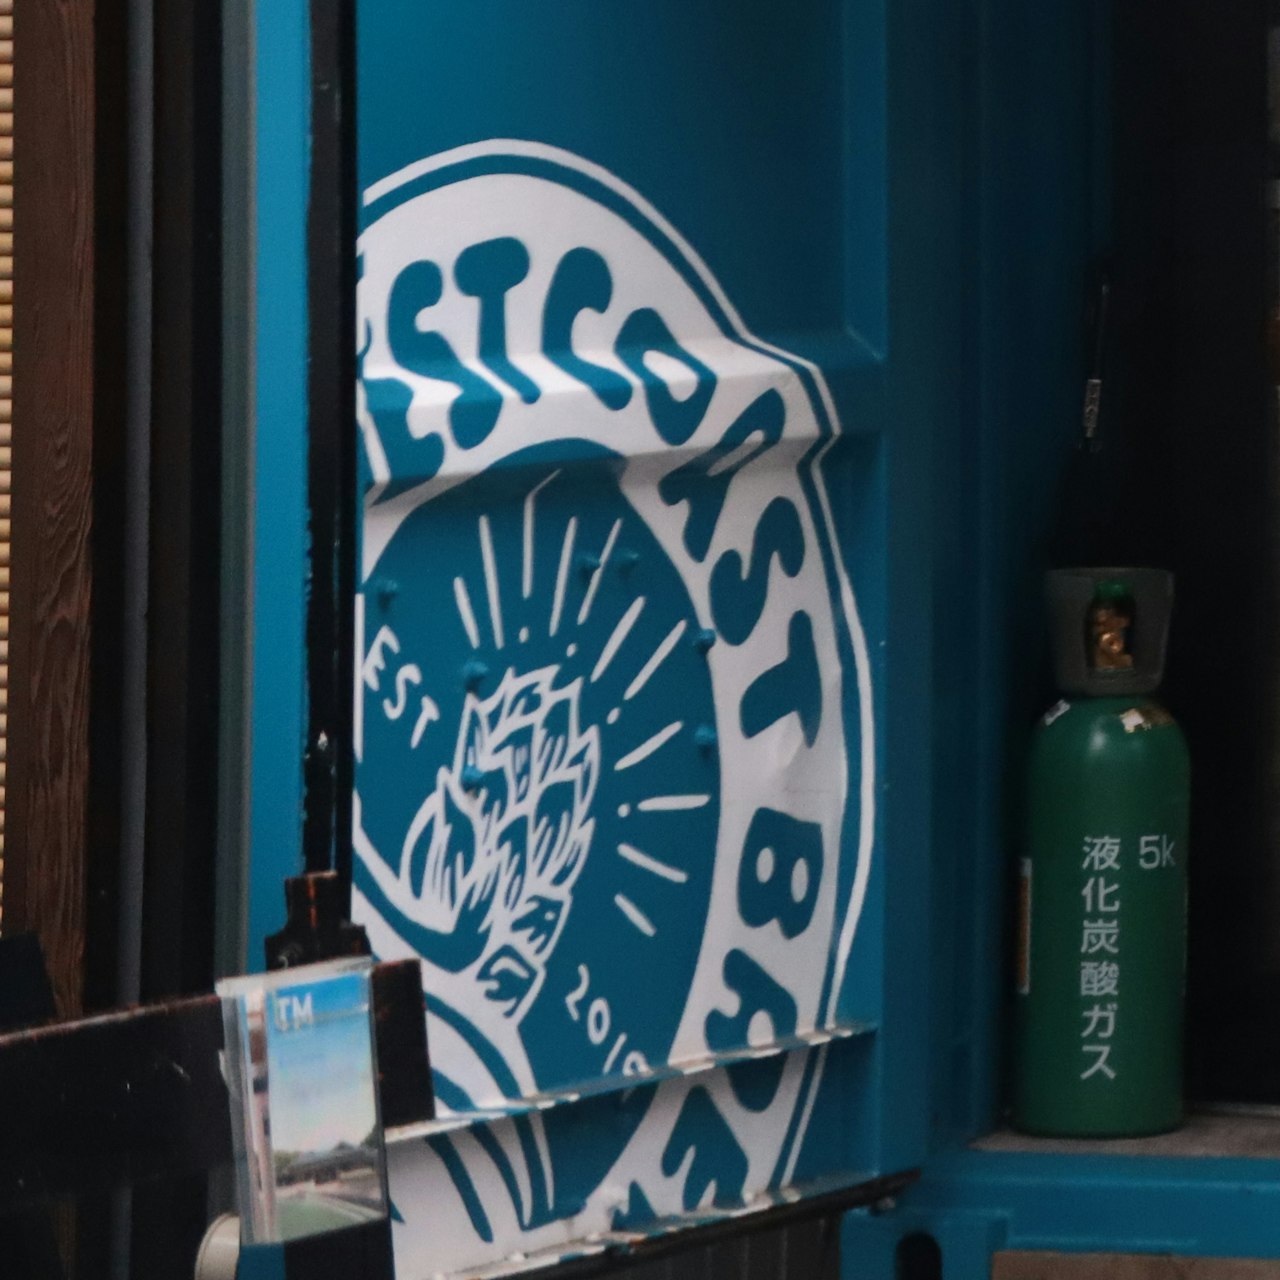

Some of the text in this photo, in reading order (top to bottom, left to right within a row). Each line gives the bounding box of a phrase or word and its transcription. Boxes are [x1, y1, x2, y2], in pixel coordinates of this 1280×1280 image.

[541, 247, 823, 749] COAST
[1080, 835, 1121, 1080] 液化炭酸ガス
